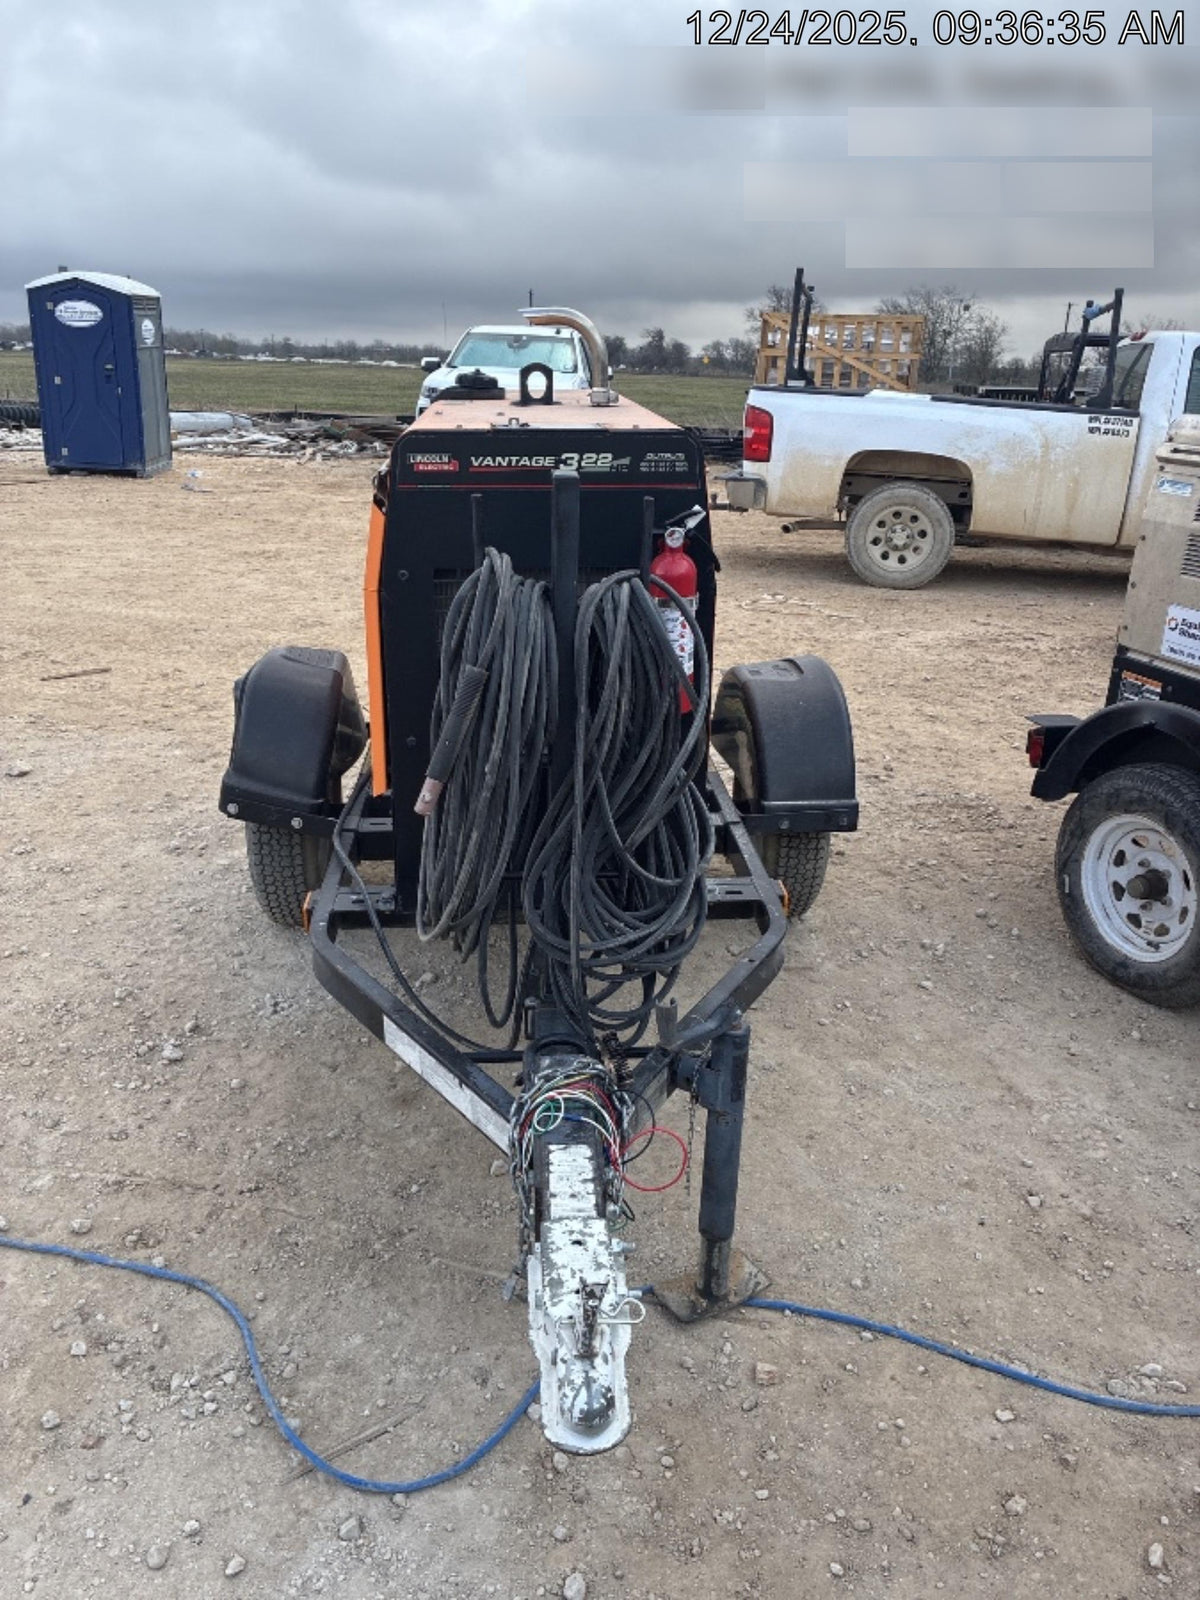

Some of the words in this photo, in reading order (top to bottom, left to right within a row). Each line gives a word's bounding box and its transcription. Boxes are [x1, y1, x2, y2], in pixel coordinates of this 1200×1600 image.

[409, 454, 449, 463] LINCOLN
[470, 456, 556, 467] VANTAGE
[559, 453, 613, 471] 322
